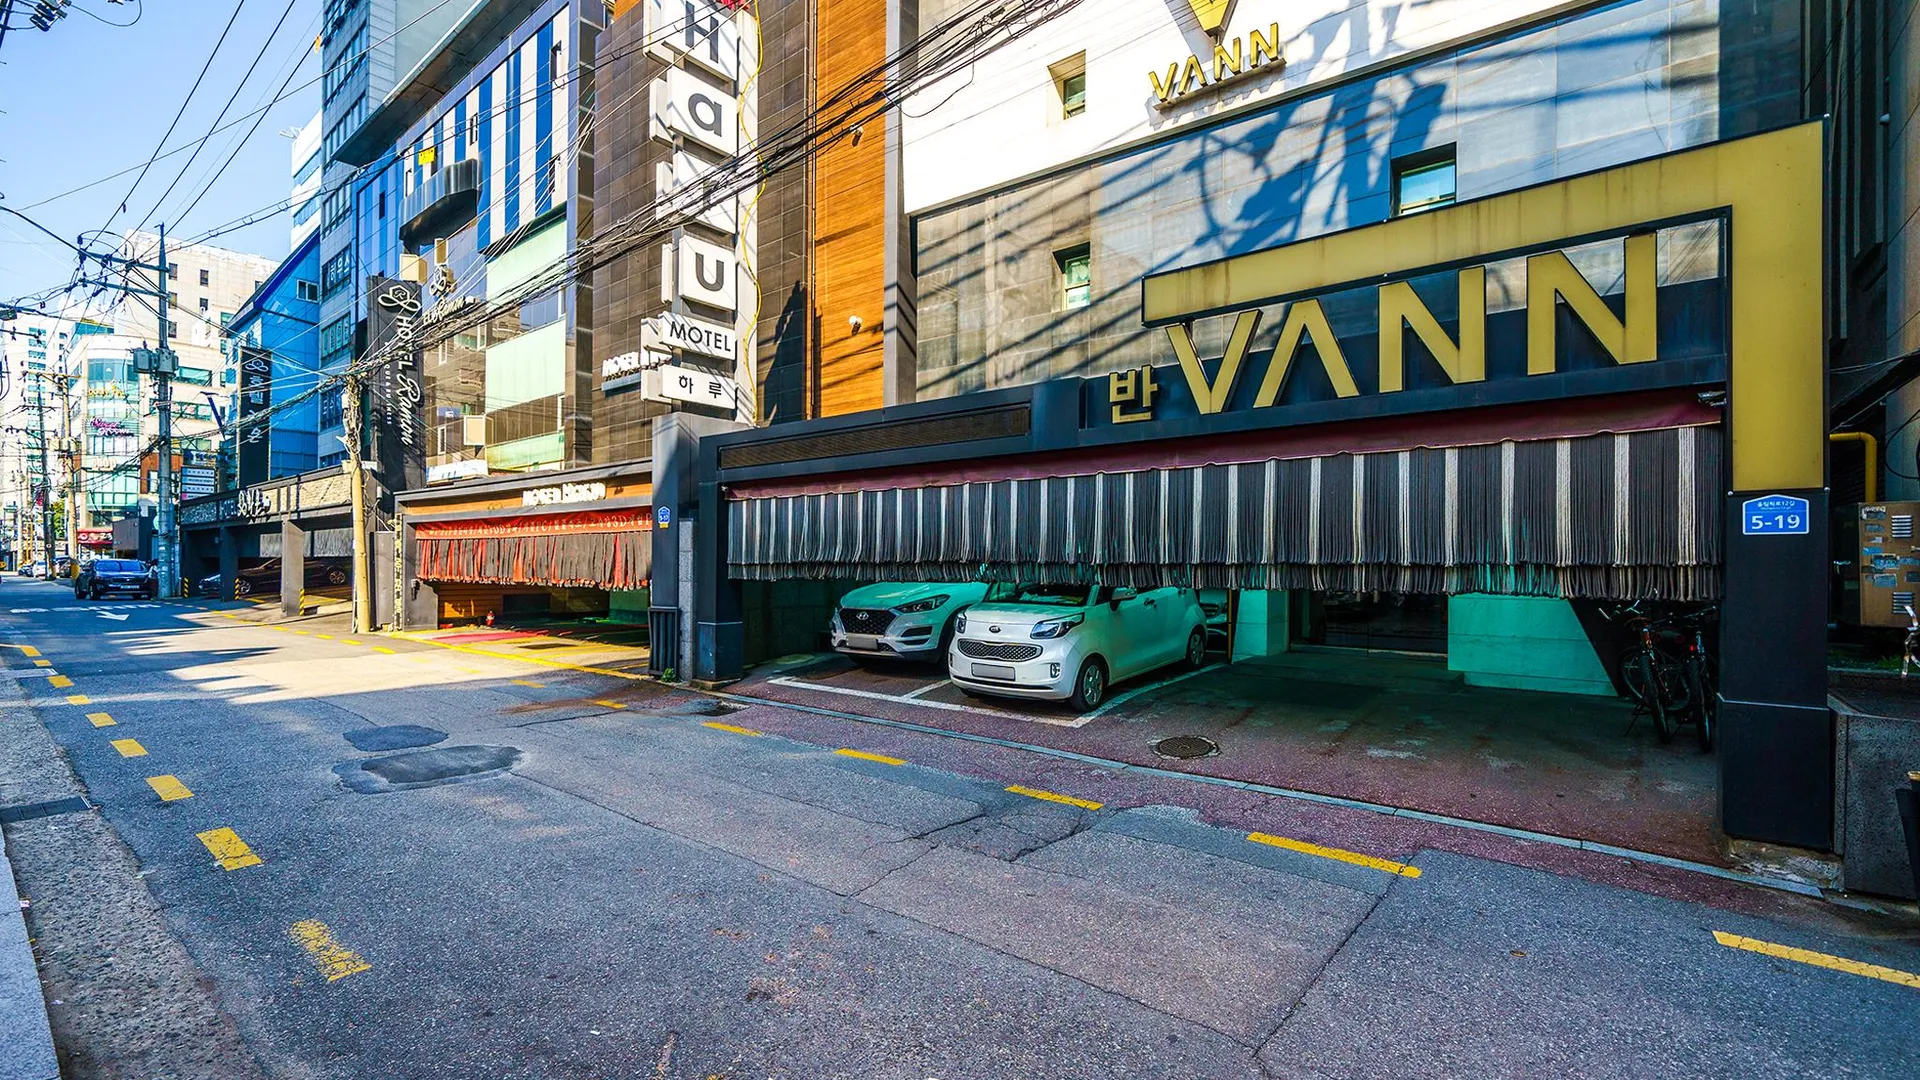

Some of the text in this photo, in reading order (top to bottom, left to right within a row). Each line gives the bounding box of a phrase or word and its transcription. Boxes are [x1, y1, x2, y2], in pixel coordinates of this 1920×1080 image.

[1149, 22, 1279, 102] VANN
[670, 321, 732, 352] MOTEL
[1165, 232, 1658, 414] VANN
[397, 372, 422, 446] Ramon
[678, 375, 722, 397] 하루
[1109, 364, 1158, 424] 반
[1751, 514, 1801, 530] 5-19
